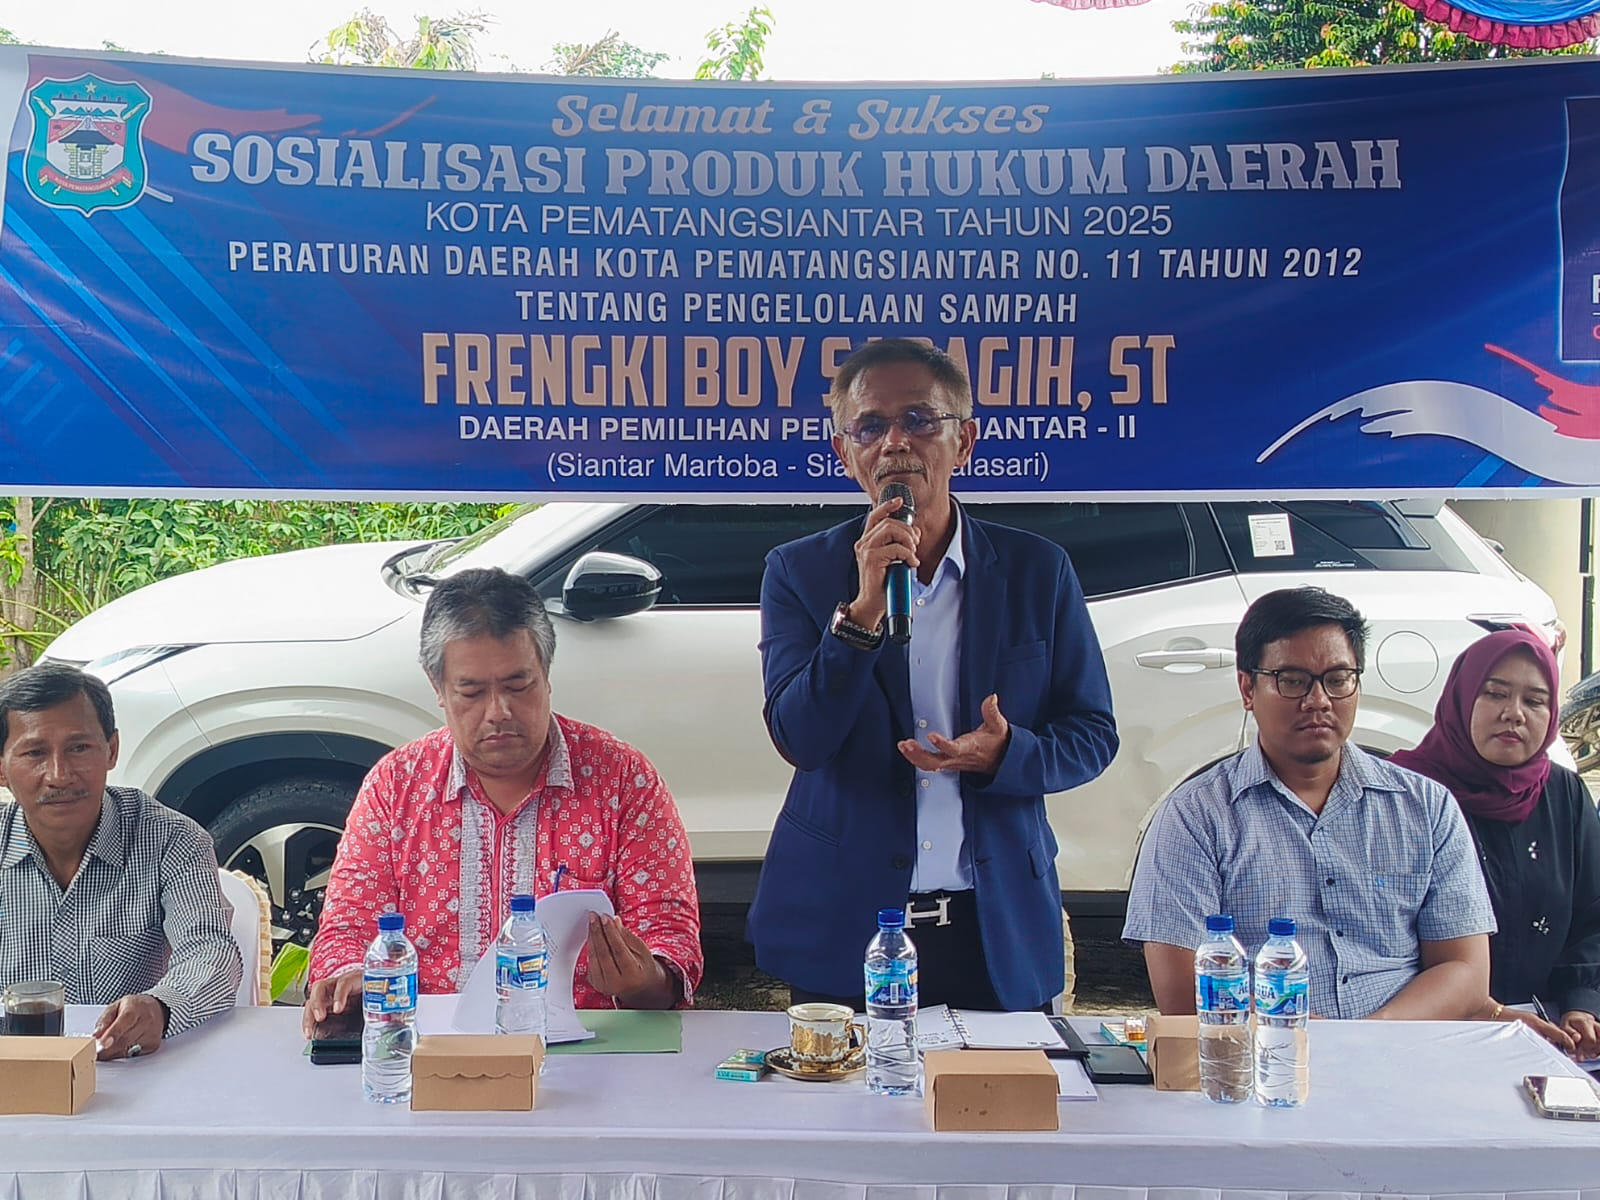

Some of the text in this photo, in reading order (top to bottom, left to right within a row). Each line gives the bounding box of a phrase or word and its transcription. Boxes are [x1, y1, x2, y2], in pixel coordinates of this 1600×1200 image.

[551, 92, 1050, 140] Selamat & Sukses
[191, 133, 1401, 197] SOSIALISASI PRODUK HUKUM DAERAH
[426, 201, 1173, 238] KOTA PEMATANGSIANTAR TAHUN 2025
[229, 241, 1362, 280] PERATURAN DAERAH KOTA PEMATANGSIANTAR NO. 11 TAHUN 2012
[515, 290, 1077, 324] TENTANG PENGELOLAAN SAMPAH
[422, 332, 667, 407] FRENGKI
[684, 335, 805, 408] BOY
[1109, 335, 1176, 405] ST
[459, 415, 588, 440] DAERAH
[600, 417, 769, 441] PEMILIHAN
[1118, 415, 1136, 438] II
[547, 452, 655, 482] (Siantar
[664, 453, 779, 477] Martoba
